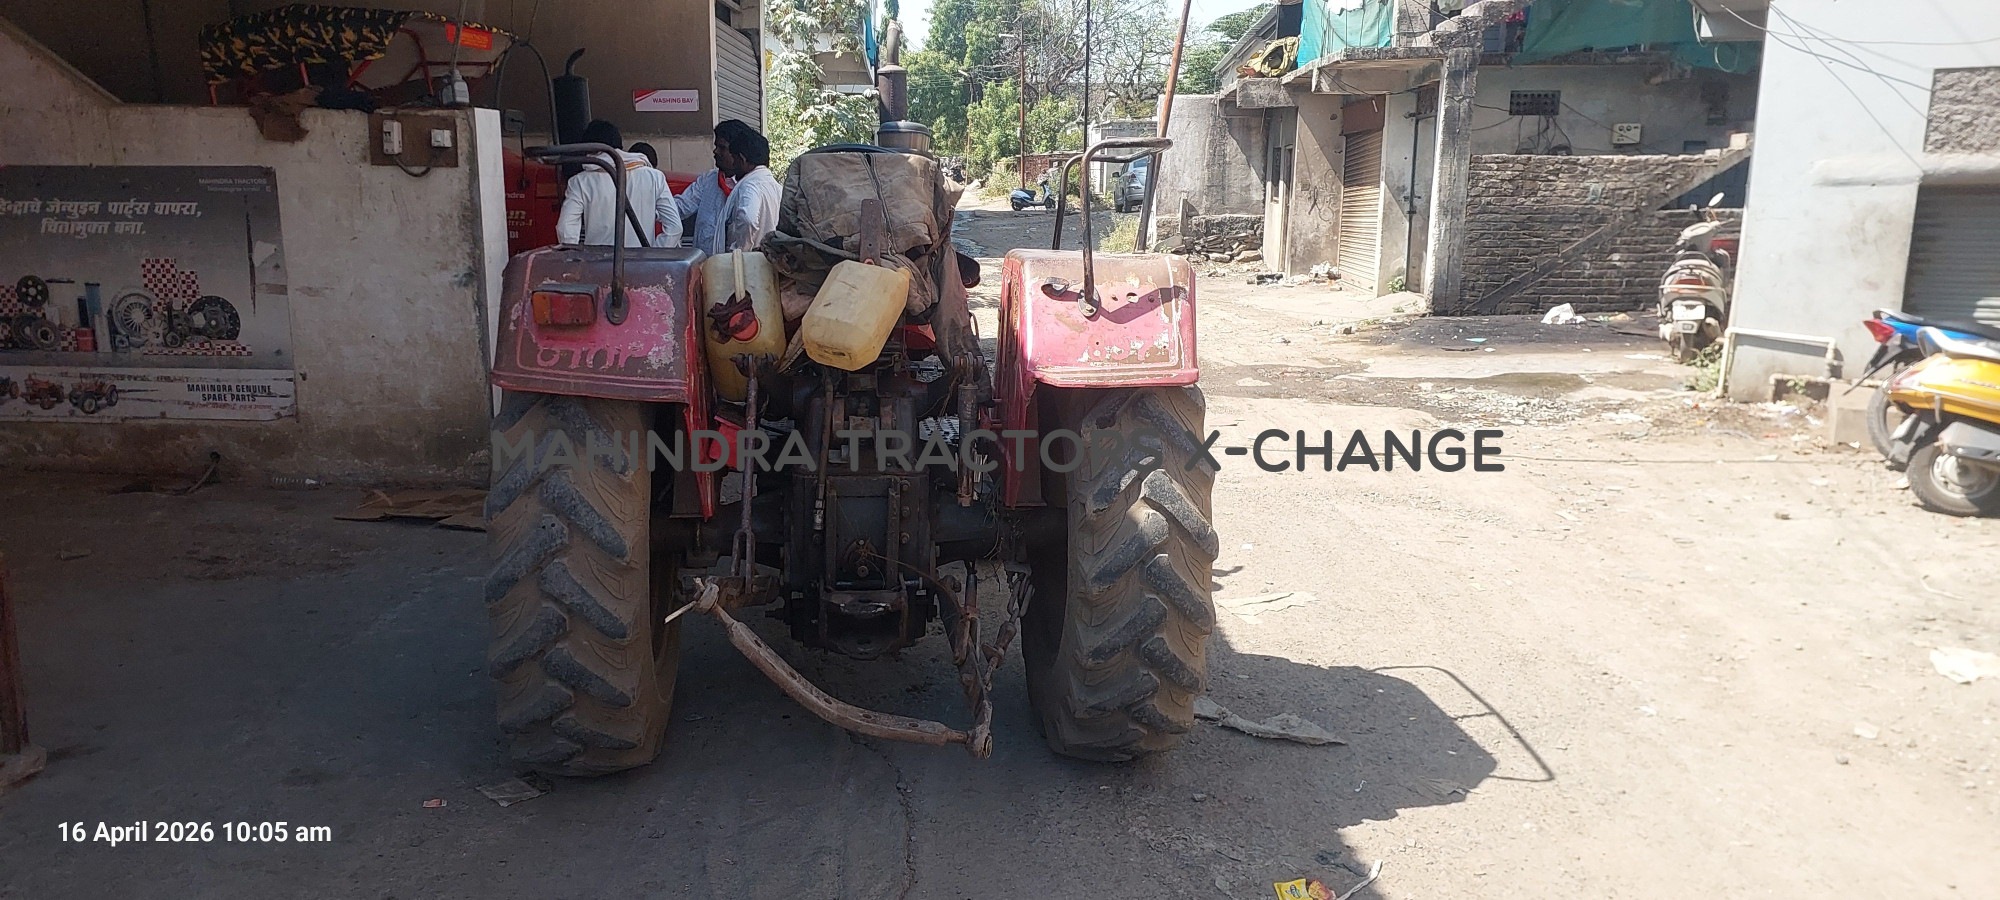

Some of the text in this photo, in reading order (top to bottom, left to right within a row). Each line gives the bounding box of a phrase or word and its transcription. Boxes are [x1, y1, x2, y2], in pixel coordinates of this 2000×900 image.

[154, 202, 202, 218] वापरा,
[187, 384, 272, 394] MAHINDRA GENUINE
[201, 393, 257, 402] SPARE PARTS
